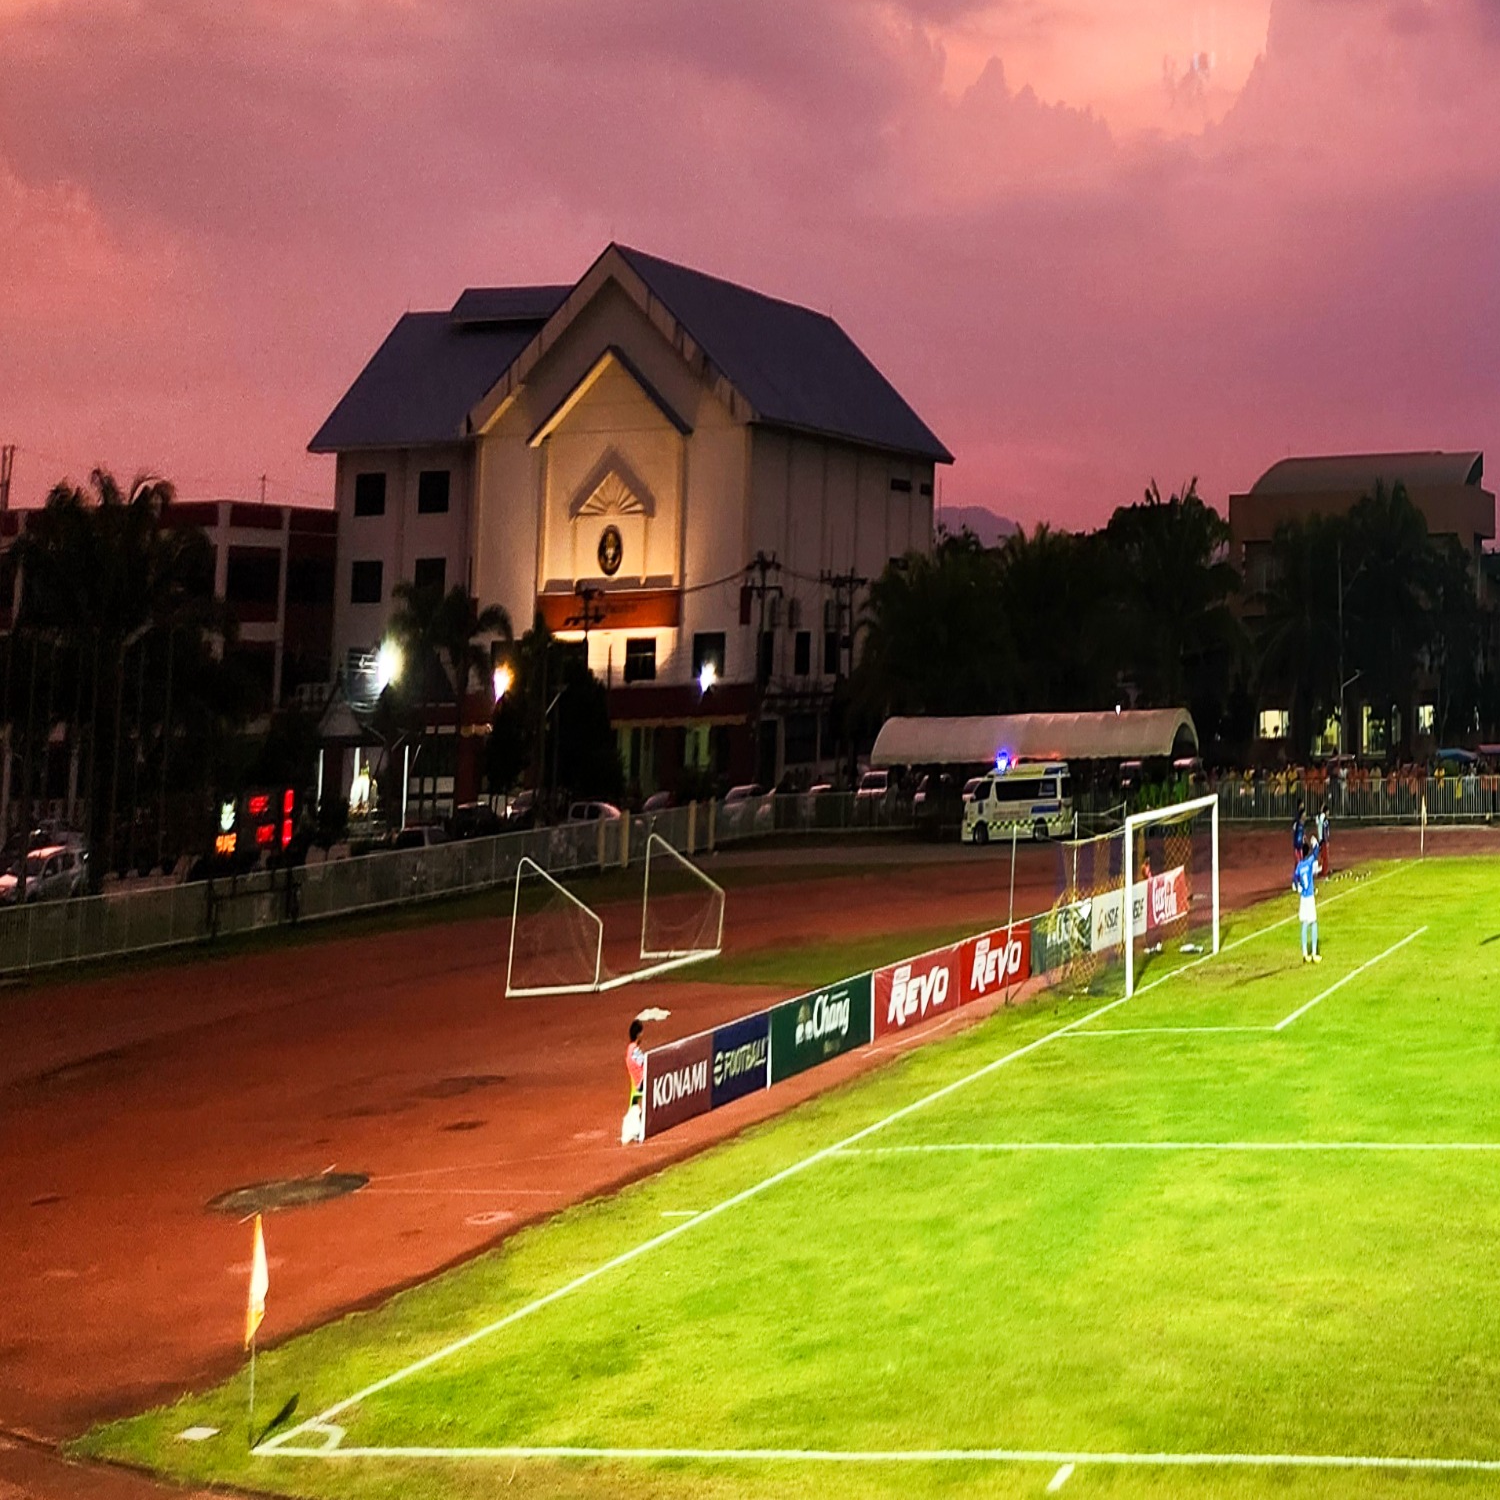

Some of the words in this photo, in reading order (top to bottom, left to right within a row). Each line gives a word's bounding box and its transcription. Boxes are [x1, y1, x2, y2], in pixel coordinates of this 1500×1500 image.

[813, 994, 850, 1038] Chang
[887, 965, 949, 1026] REVO
[653, 1059, 708, 1109] KONAMI
